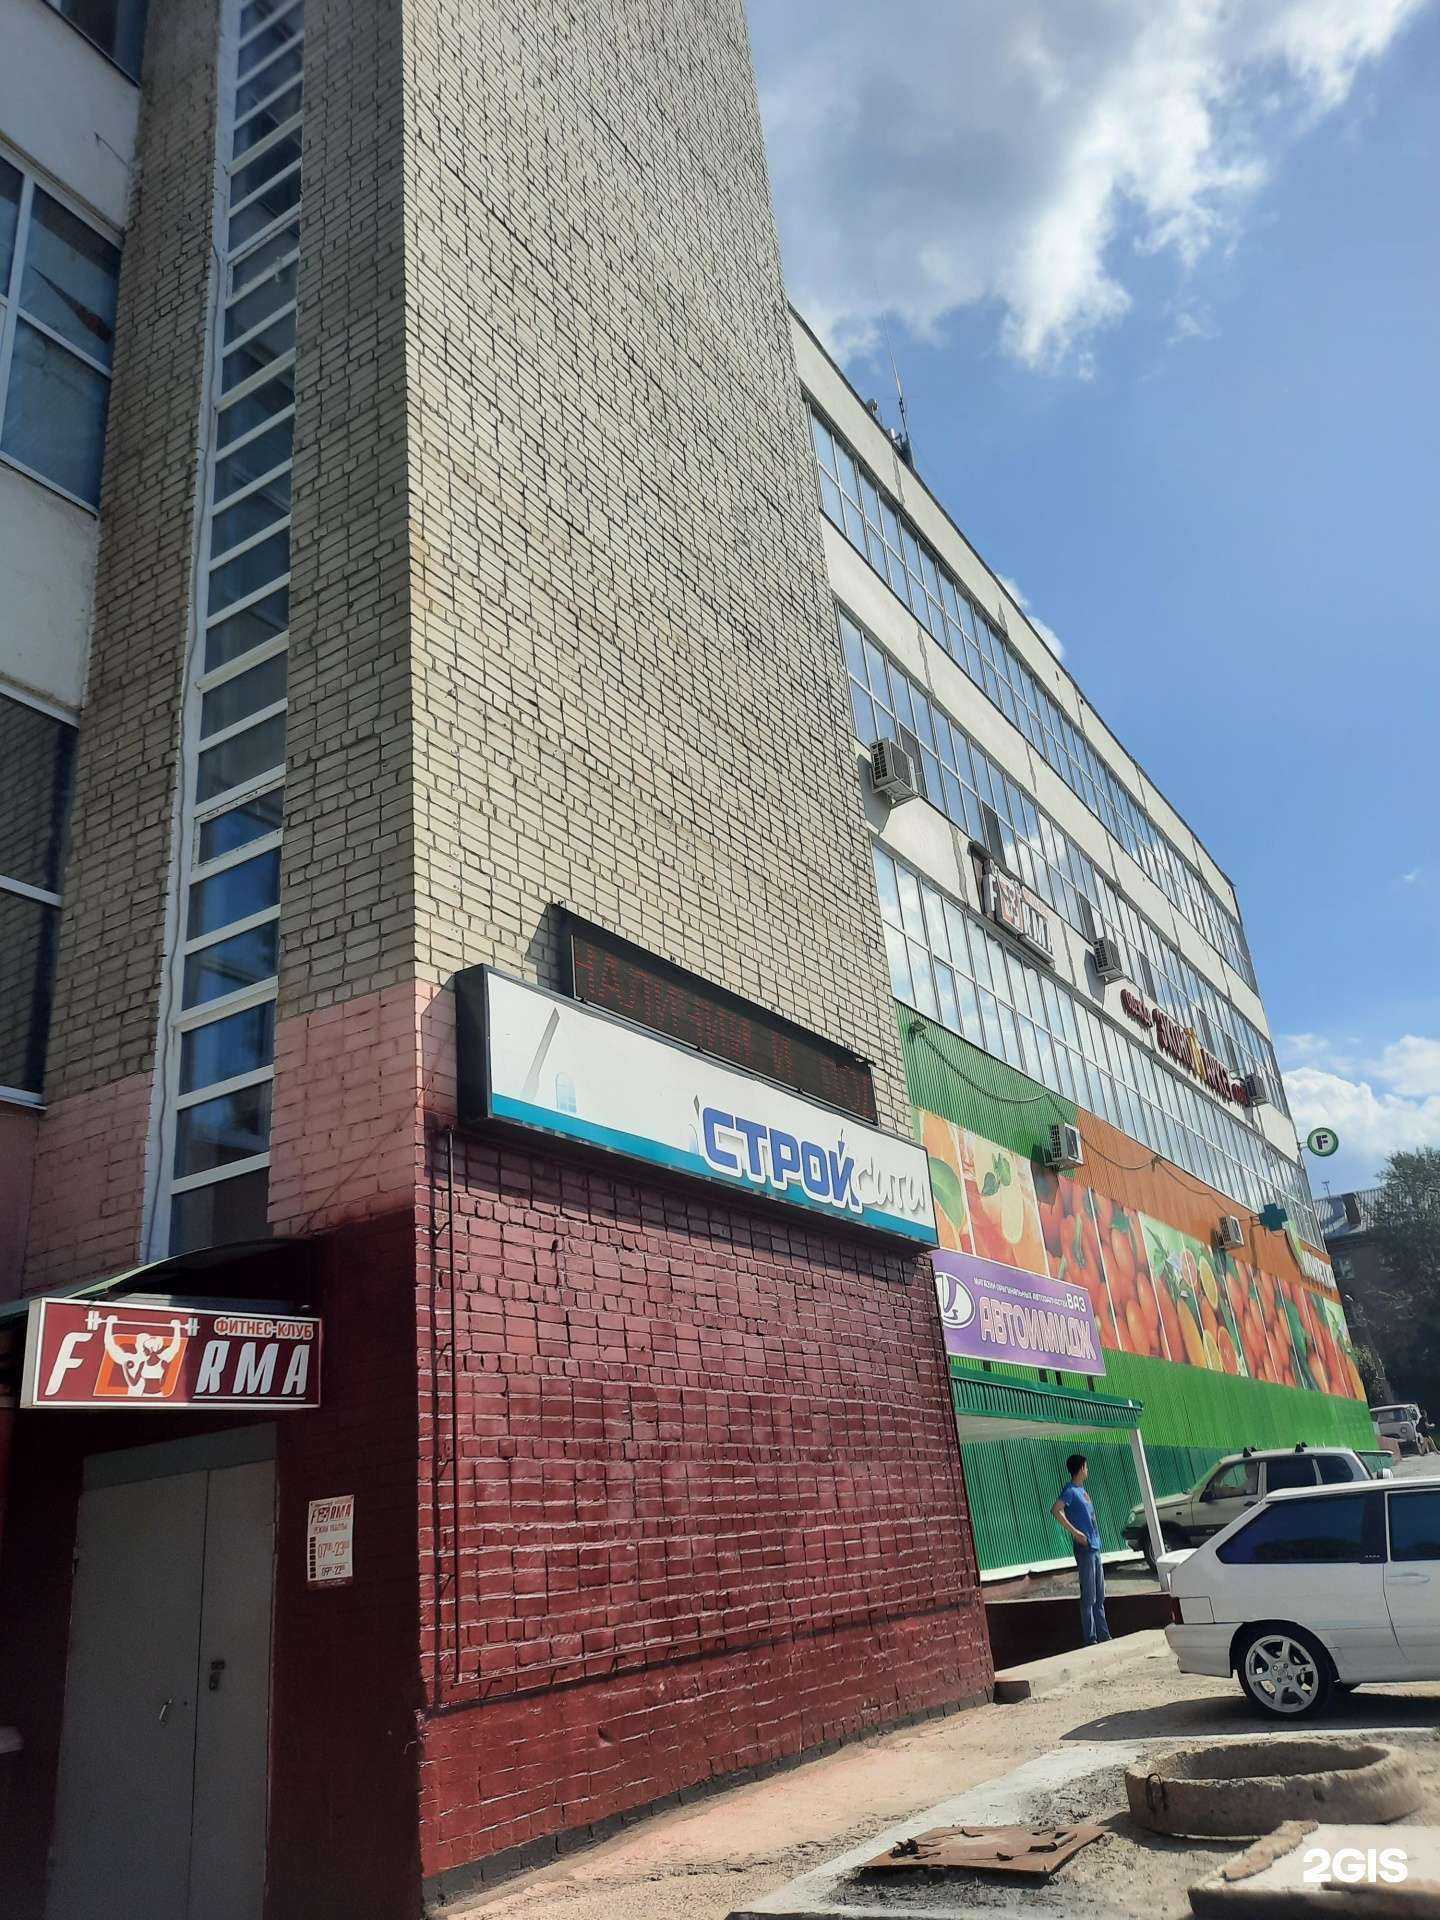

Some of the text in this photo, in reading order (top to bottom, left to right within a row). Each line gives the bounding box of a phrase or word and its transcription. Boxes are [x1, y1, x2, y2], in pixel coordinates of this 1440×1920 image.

[1066, 1293, 1087, 1313] ВАЗ
[214, 1317, 313, 1340] ФИТНЕС-КЛУБ
[979, 1296, 1097, 1360] АВТОИМИДЖ
